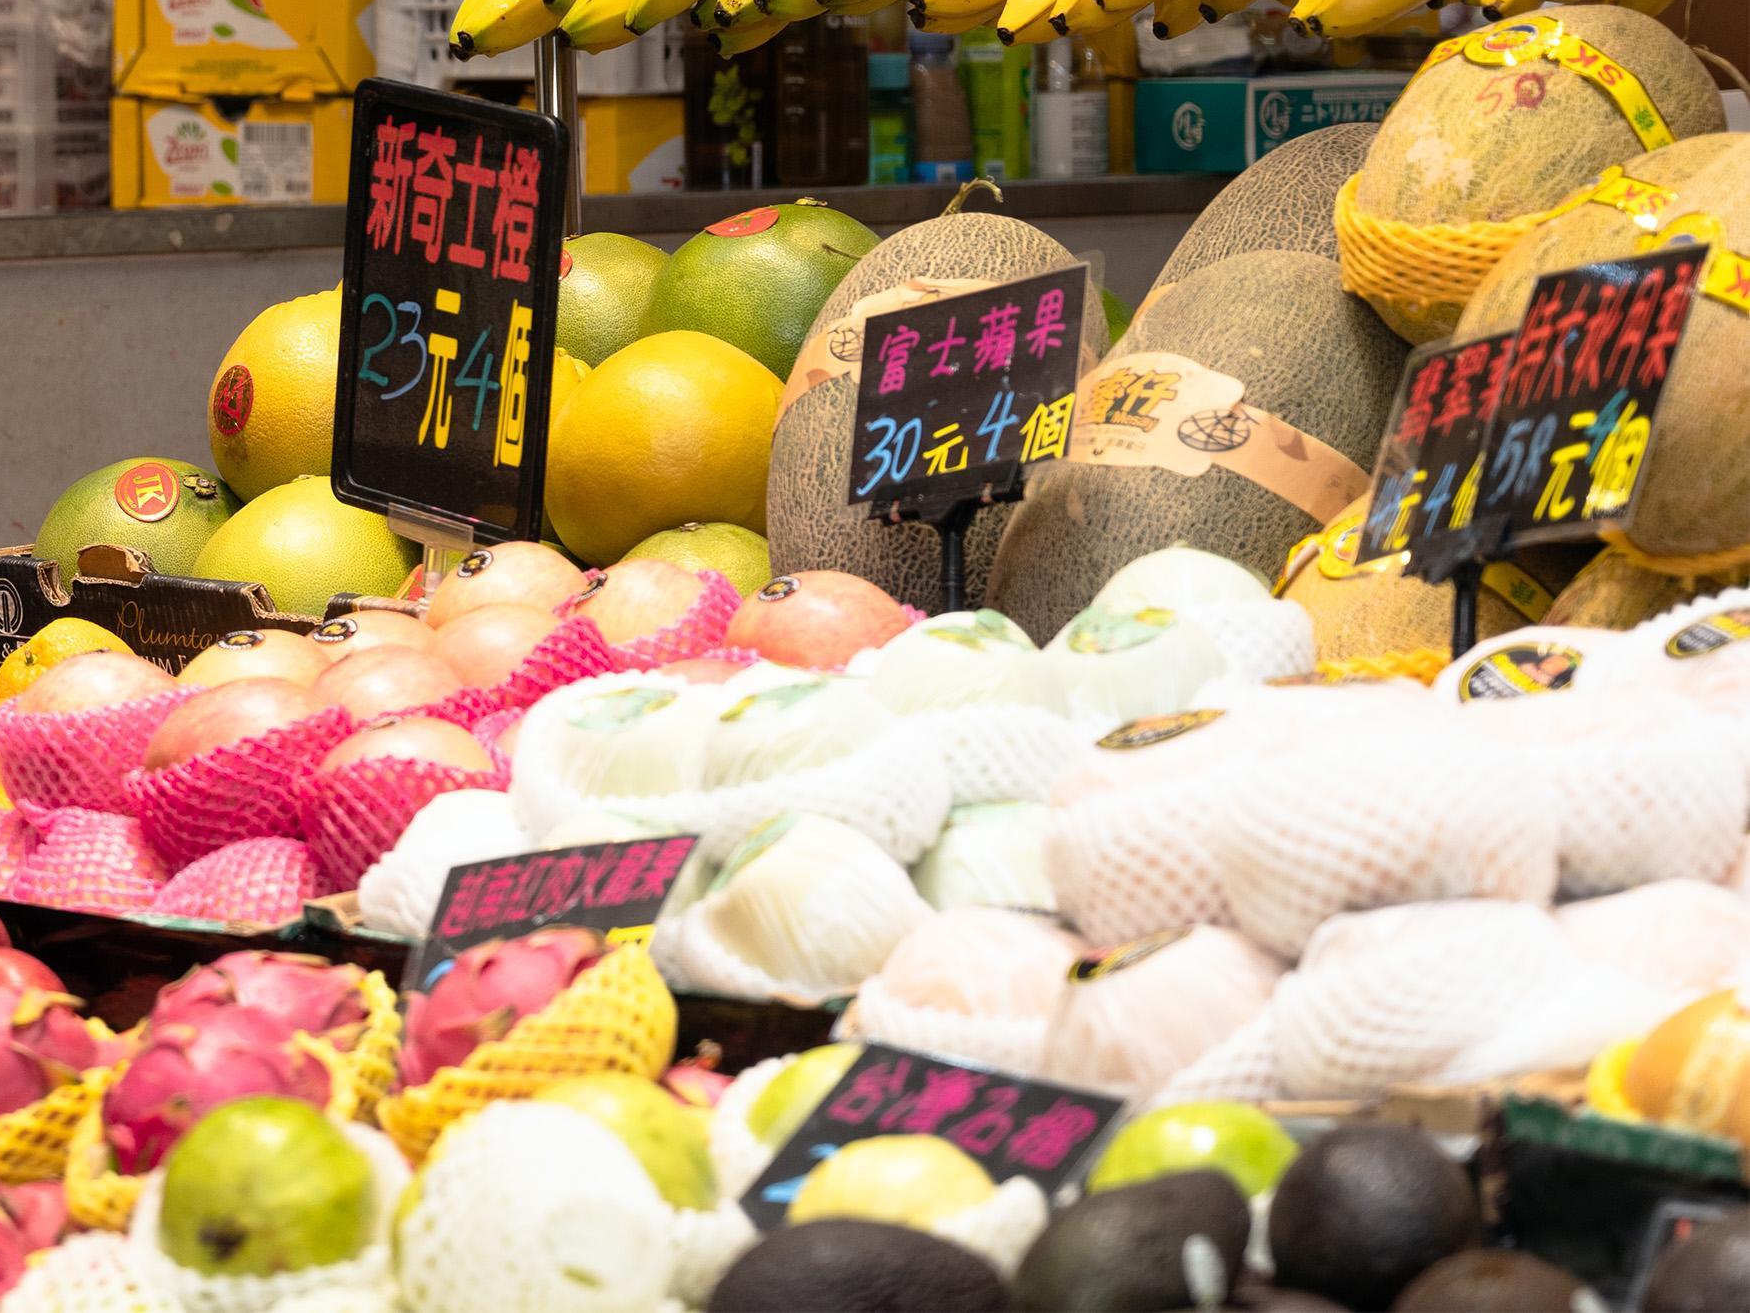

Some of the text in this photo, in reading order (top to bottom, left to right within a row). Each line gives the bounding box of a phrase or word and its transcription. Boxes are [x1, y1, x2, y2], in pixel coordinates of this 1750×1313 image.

[365, 114, 542, 283] 新奇士橙
[358, 288, 535, 469] 23元4個
[878, 288, 1067, 396] 富士蘋果
[857, 390, 1077, 497] 30元4個
[117, 599, 218, 651] Plumta
